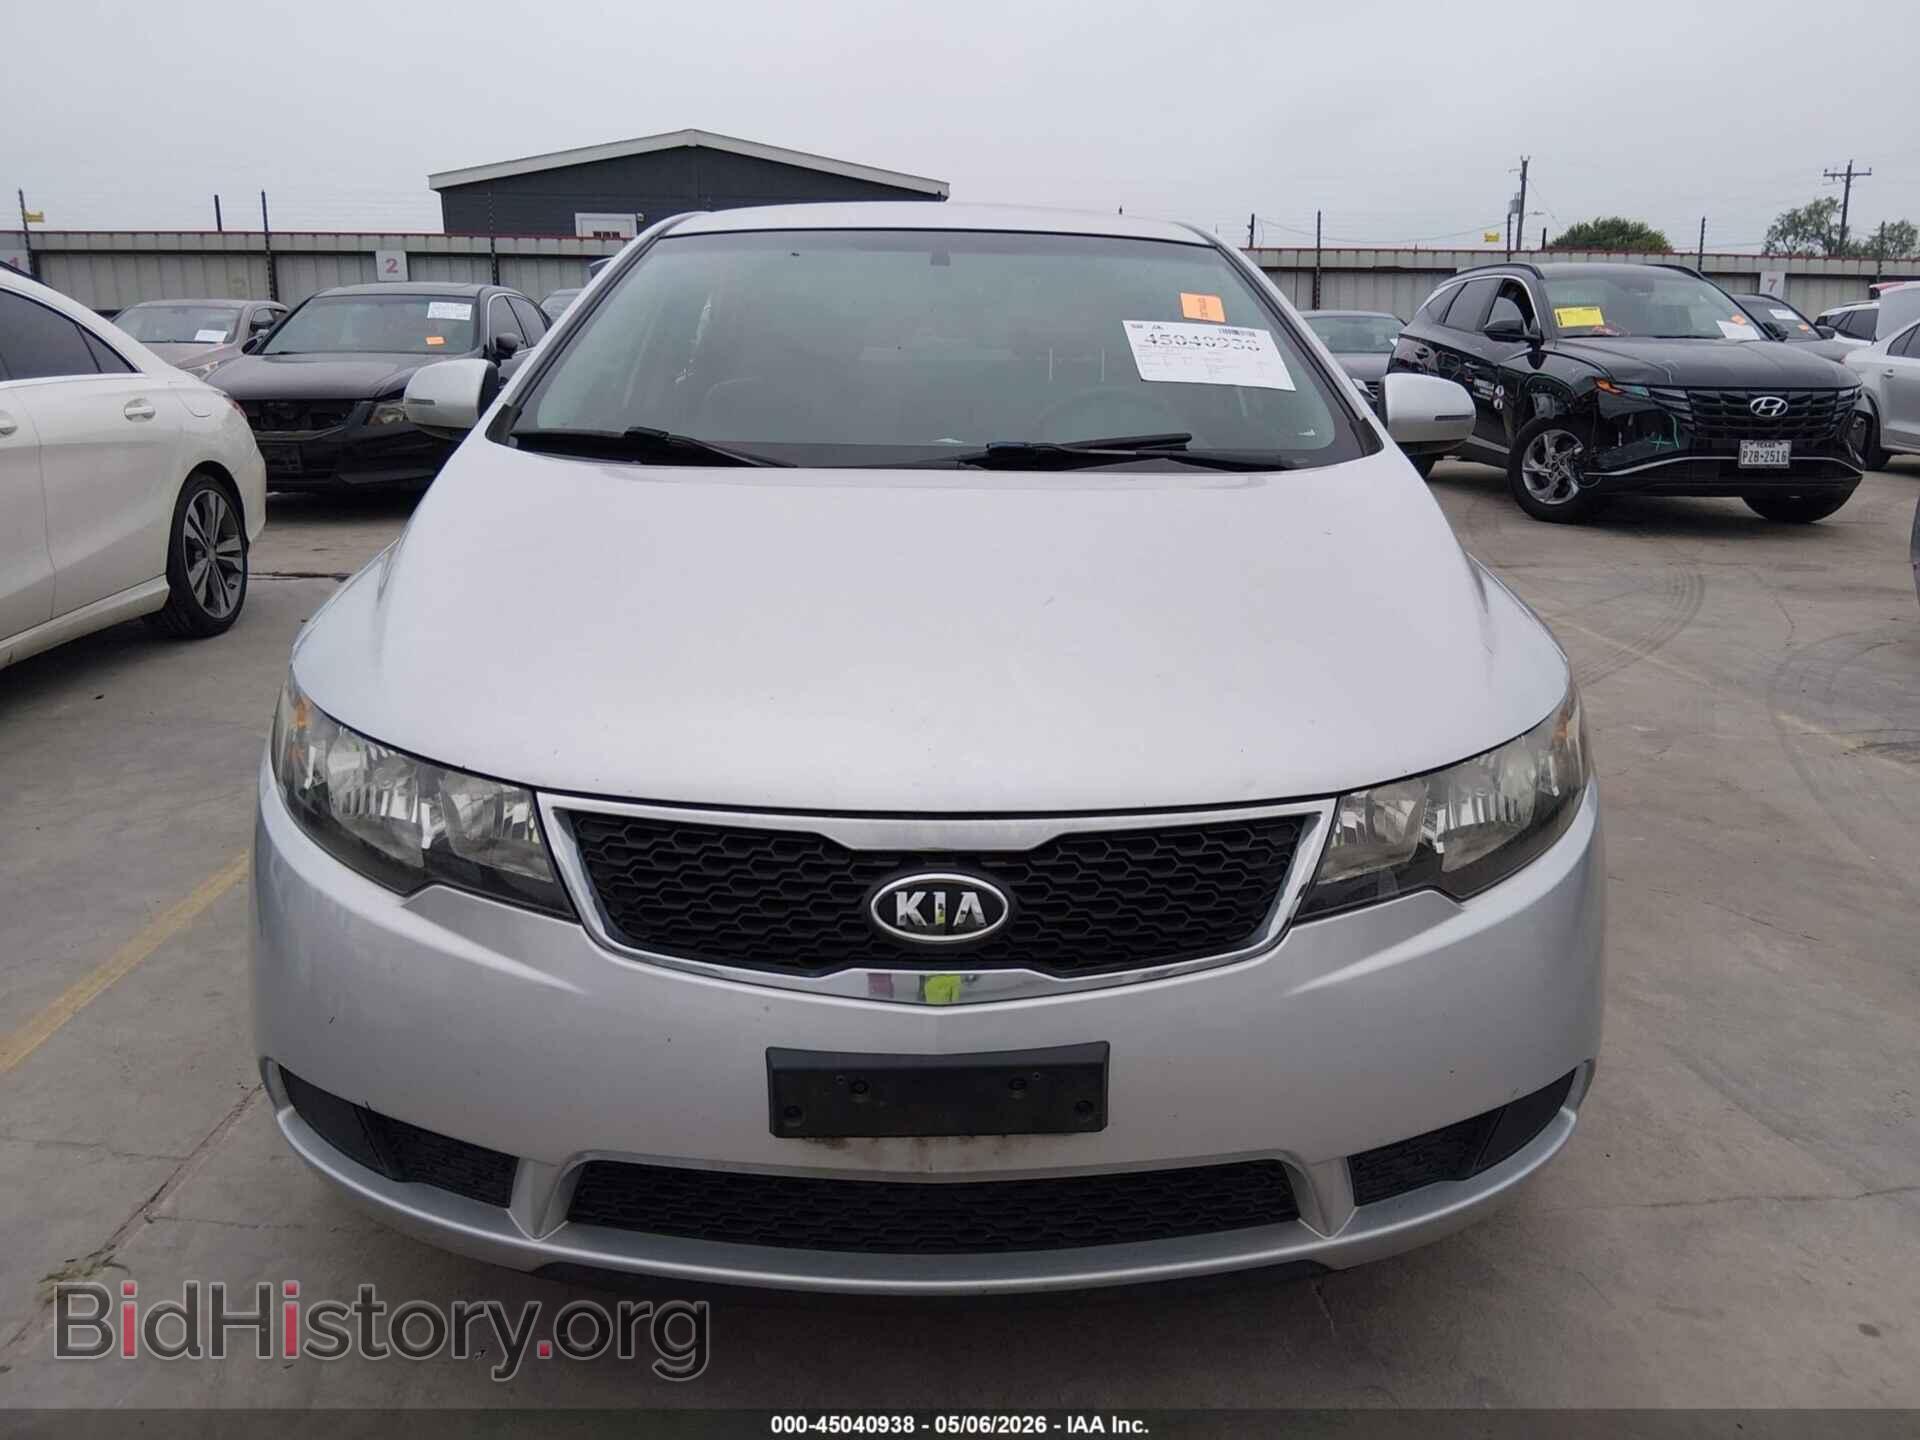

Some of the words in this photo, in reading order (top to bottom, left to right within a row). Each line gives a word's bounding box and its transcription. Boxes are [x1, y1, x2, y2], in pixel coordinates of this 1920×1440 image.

[385, 257, 399, 274] 2
[1767, 279, 1778, 293] 7
[895, 891, 987, 926] KIA
